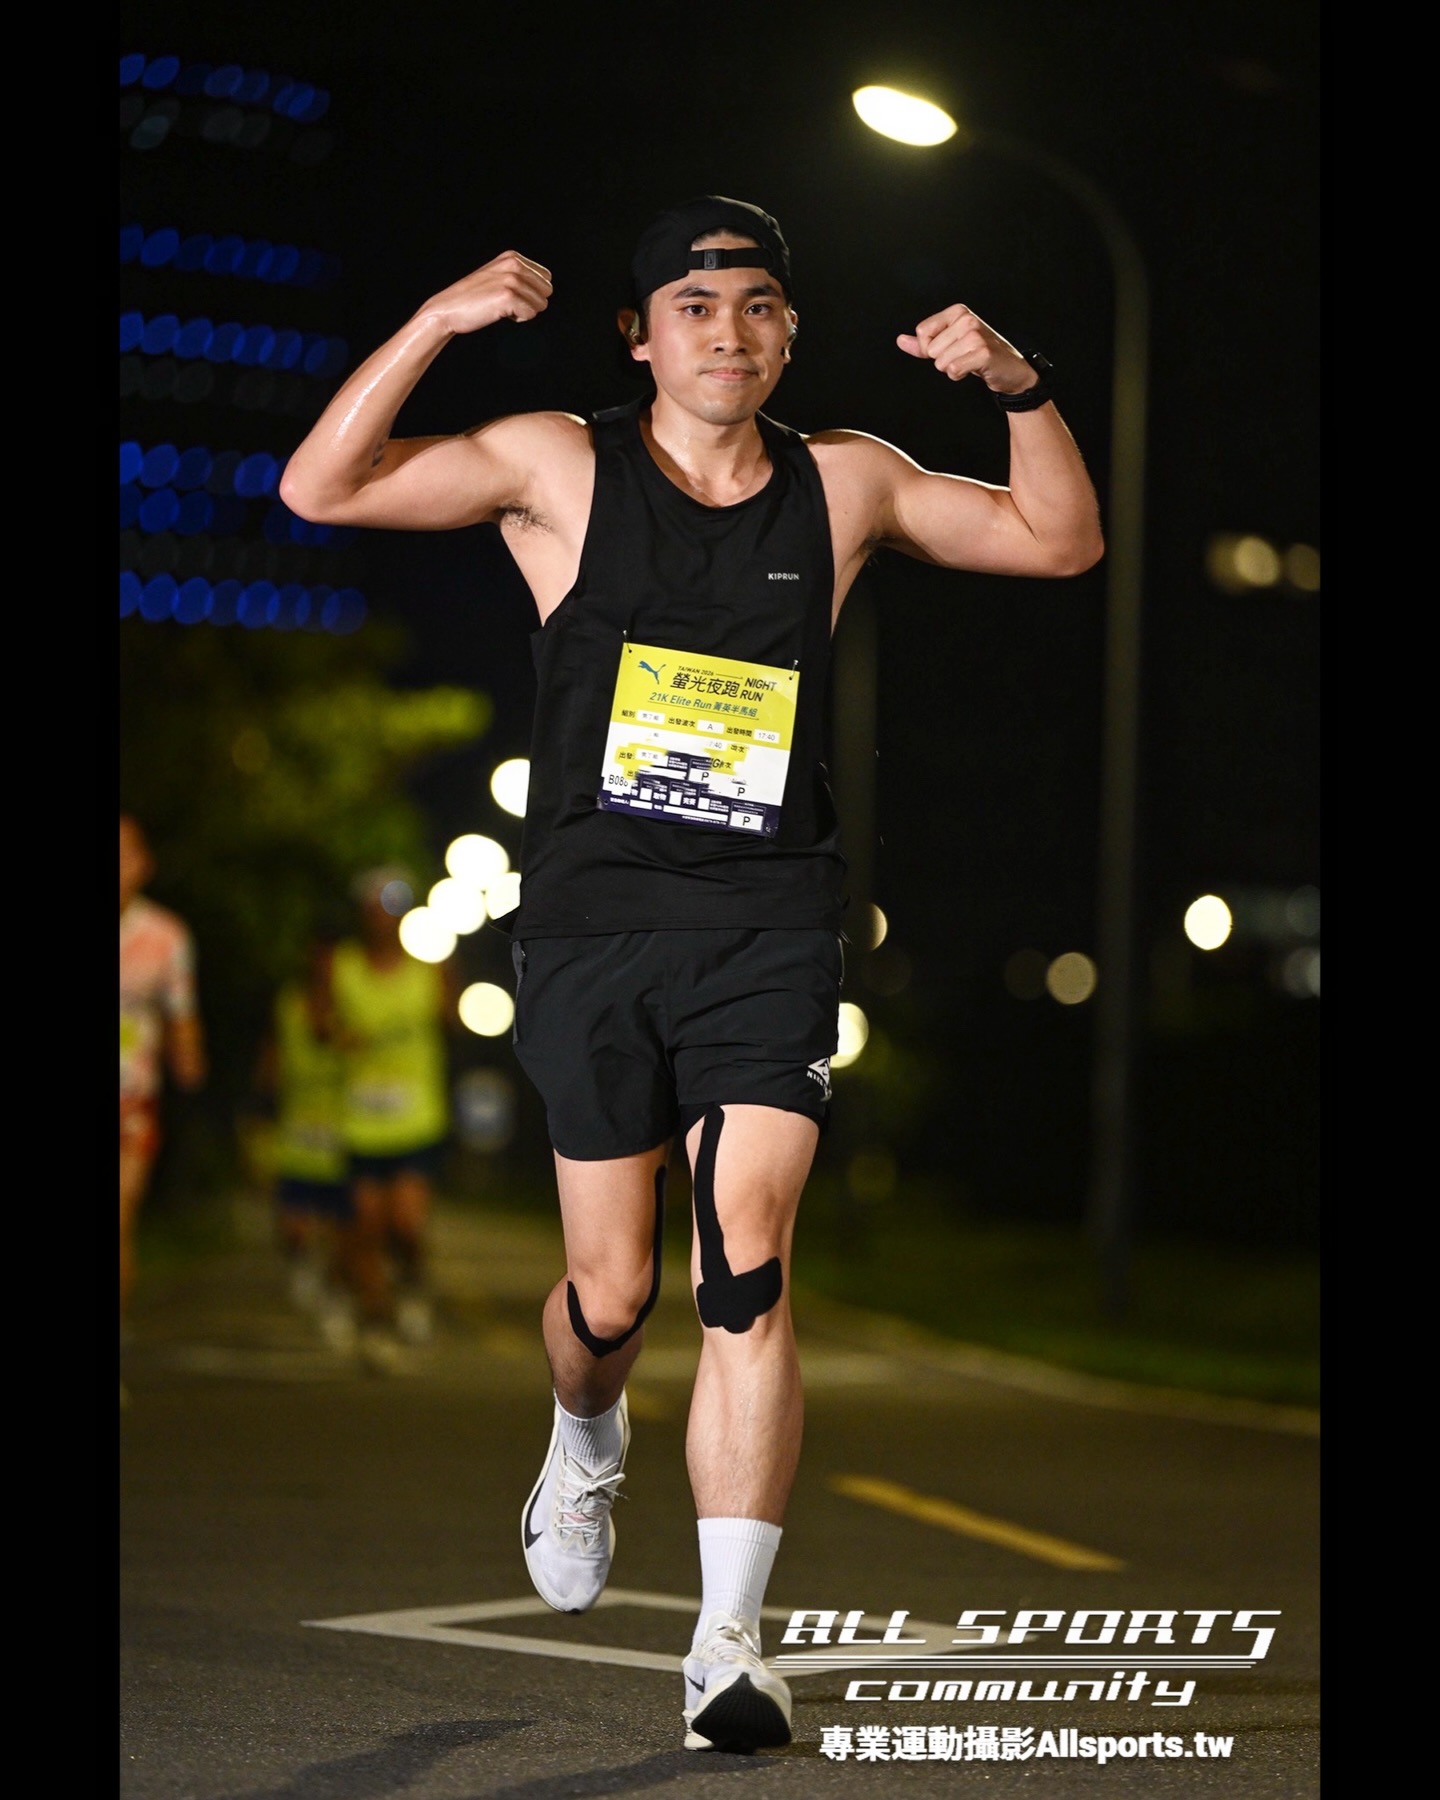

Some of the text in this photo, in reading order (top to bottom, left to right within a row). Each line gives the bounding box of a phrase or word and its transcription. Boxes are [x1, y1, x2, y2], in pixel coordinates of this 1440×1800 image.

[678, 665, 700, 674] TAIWAN
[670, 672, 740, 698] 螢光夜跑
[745, 677, 777, 691] NIGHT
[740, 690, 764, 702] RUN
[649, 692, 758, 718] 21K Elite Run 菁英半馬組
[726, 727, 752, 737] 出發時間
[758, 732, 776, 741] 17:40
[701, 772, 709, 781] P
[737, 787, 745, 796] P
[743, 816, 751, 826] P
